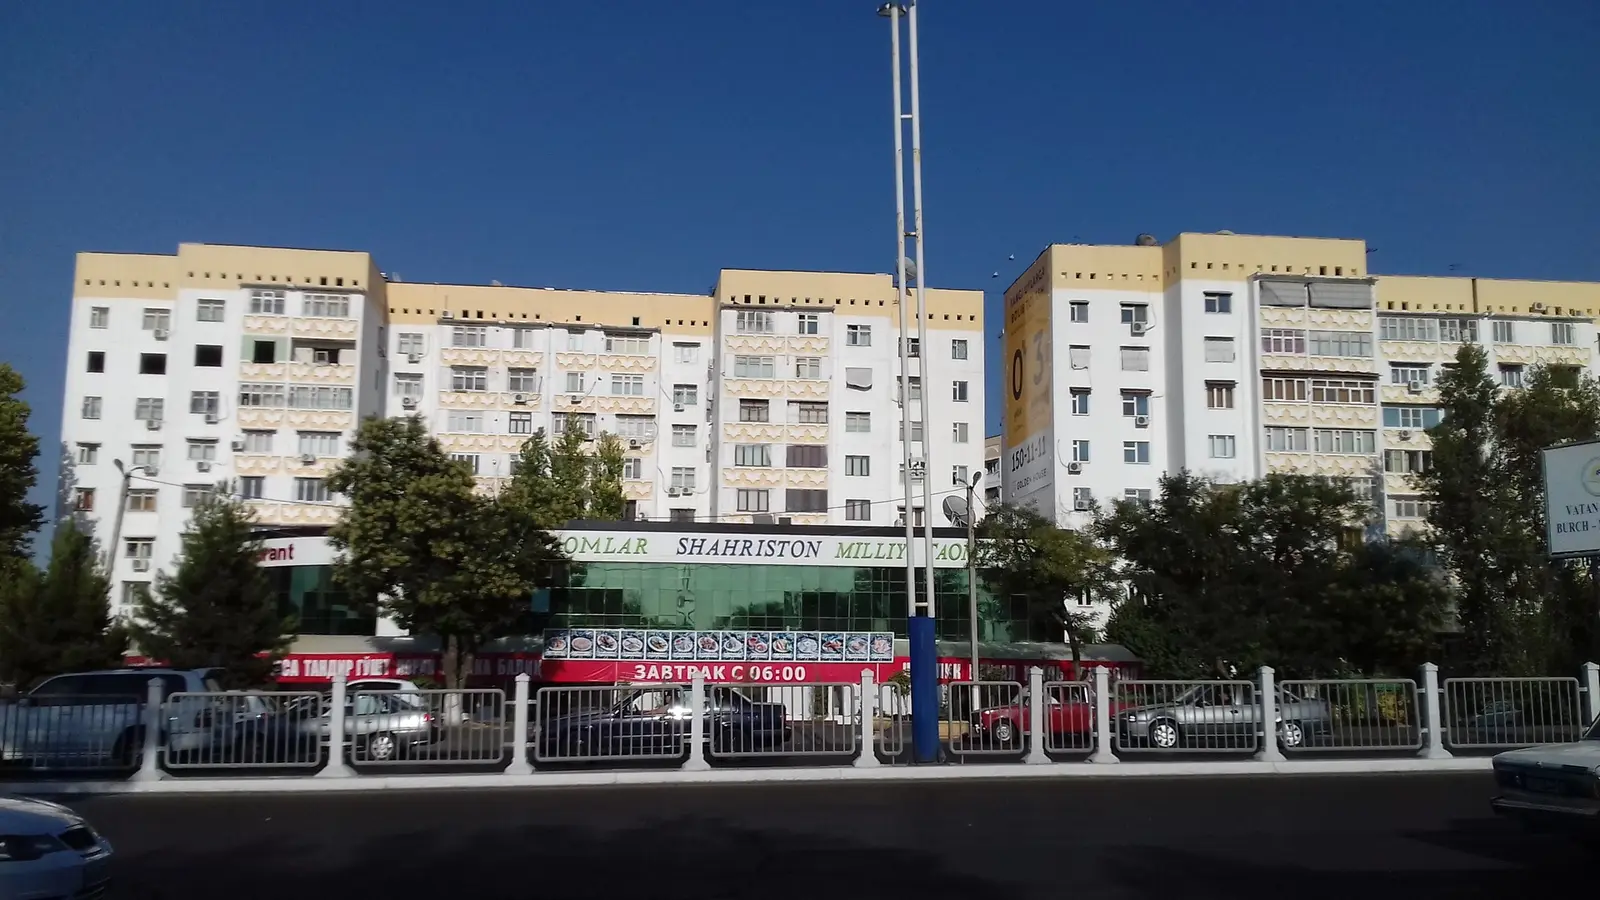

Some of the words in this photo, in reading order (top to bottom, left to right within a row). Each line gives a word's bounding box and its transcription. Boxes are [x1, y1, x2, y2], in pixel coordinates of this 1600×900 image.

[1011, 435, 1047, 473] 150-11-11
[1016, 475, 1032, 490] GOLDEN
[1556, 520, 1589, 534] BURCH
[563, 536, 648, 555] OMLAR
[676, 537, 822, 558] SHAHRISTON
[834, 541, 908, 560] MILLIY
[633, 664, 725, 681] ЗАВТРАК
[731, 664, 745, 681] С
[749, 664, 807, 681] 06:00
